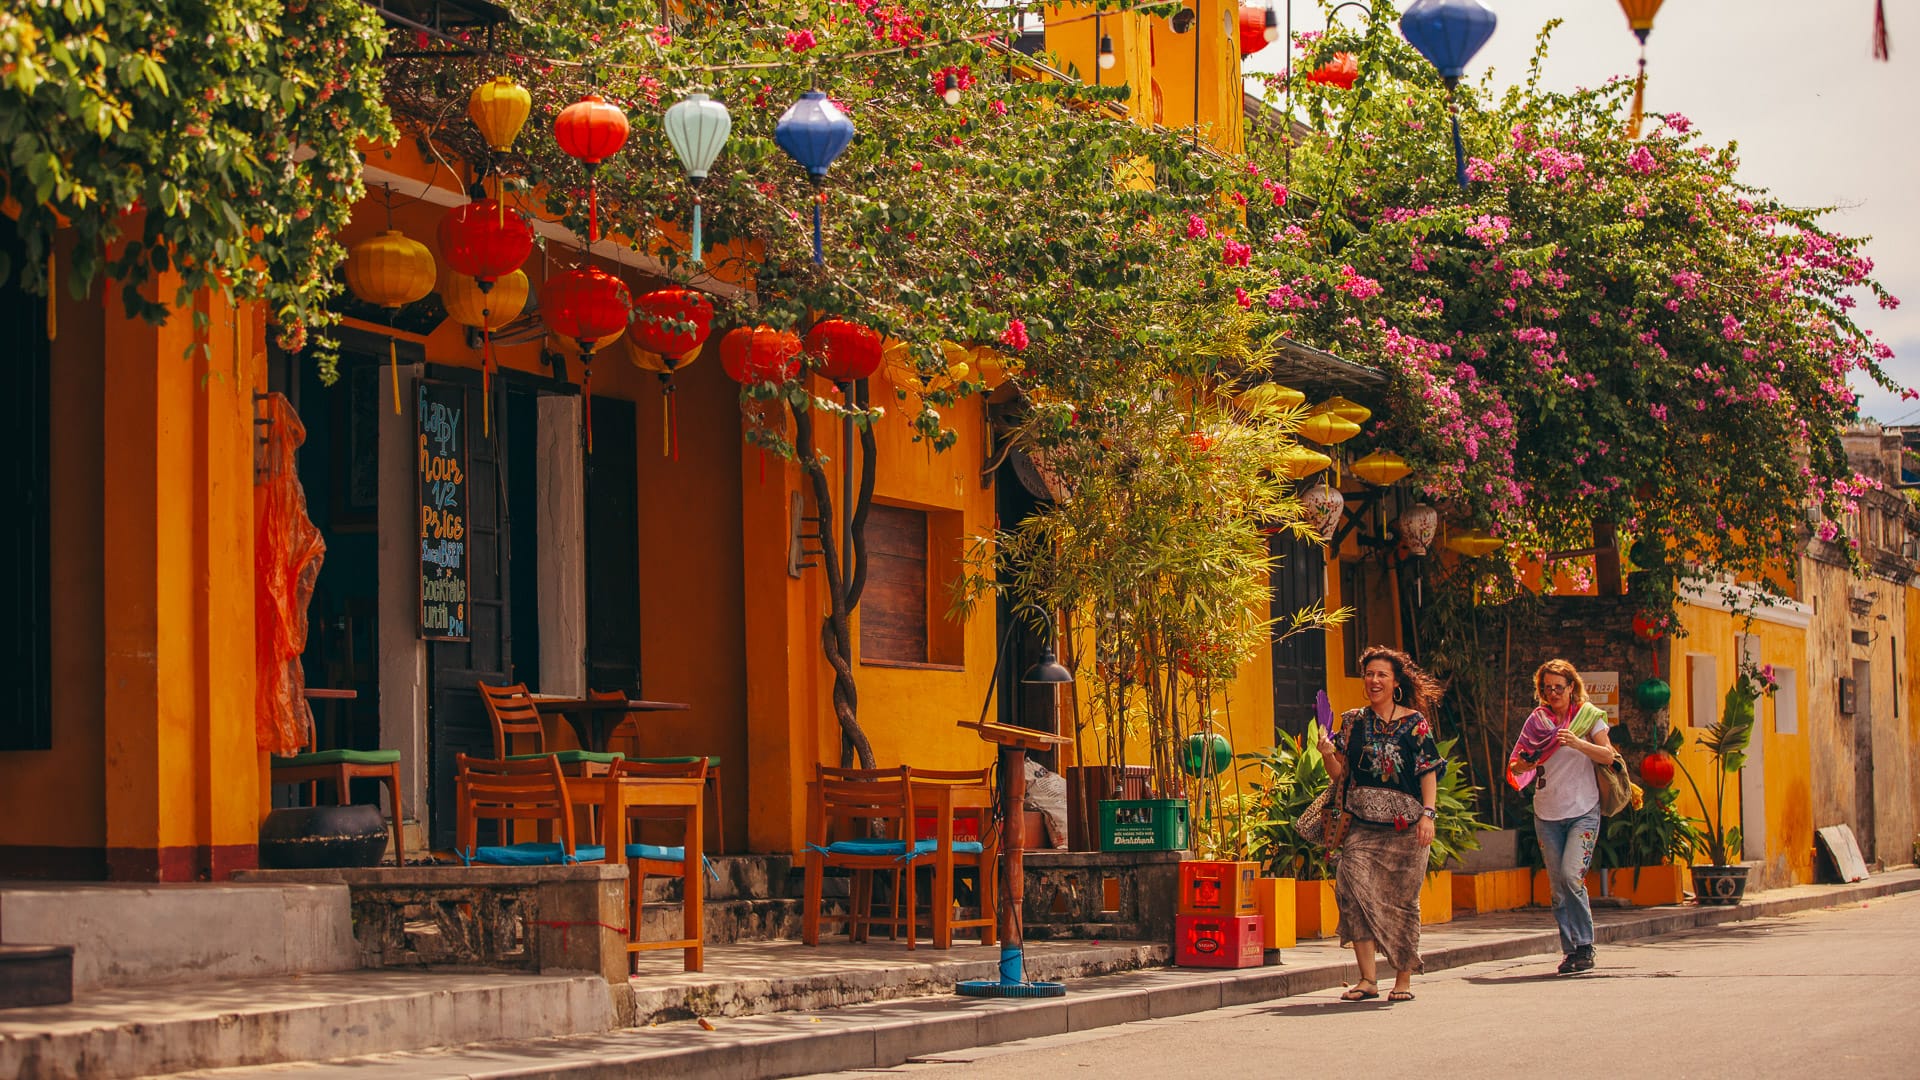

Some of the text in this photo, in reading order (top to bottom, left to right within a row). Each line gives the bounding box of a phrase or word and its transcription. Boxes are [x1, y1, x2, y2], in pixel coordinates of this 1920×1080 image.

[420, 433, 464, 485] hour
[432, 480, 458, 510] 1/2
[424, 602, 448, 628] until
[447, 615, 464, 636] PM
[1595, 682, 1616, 693] BEER
